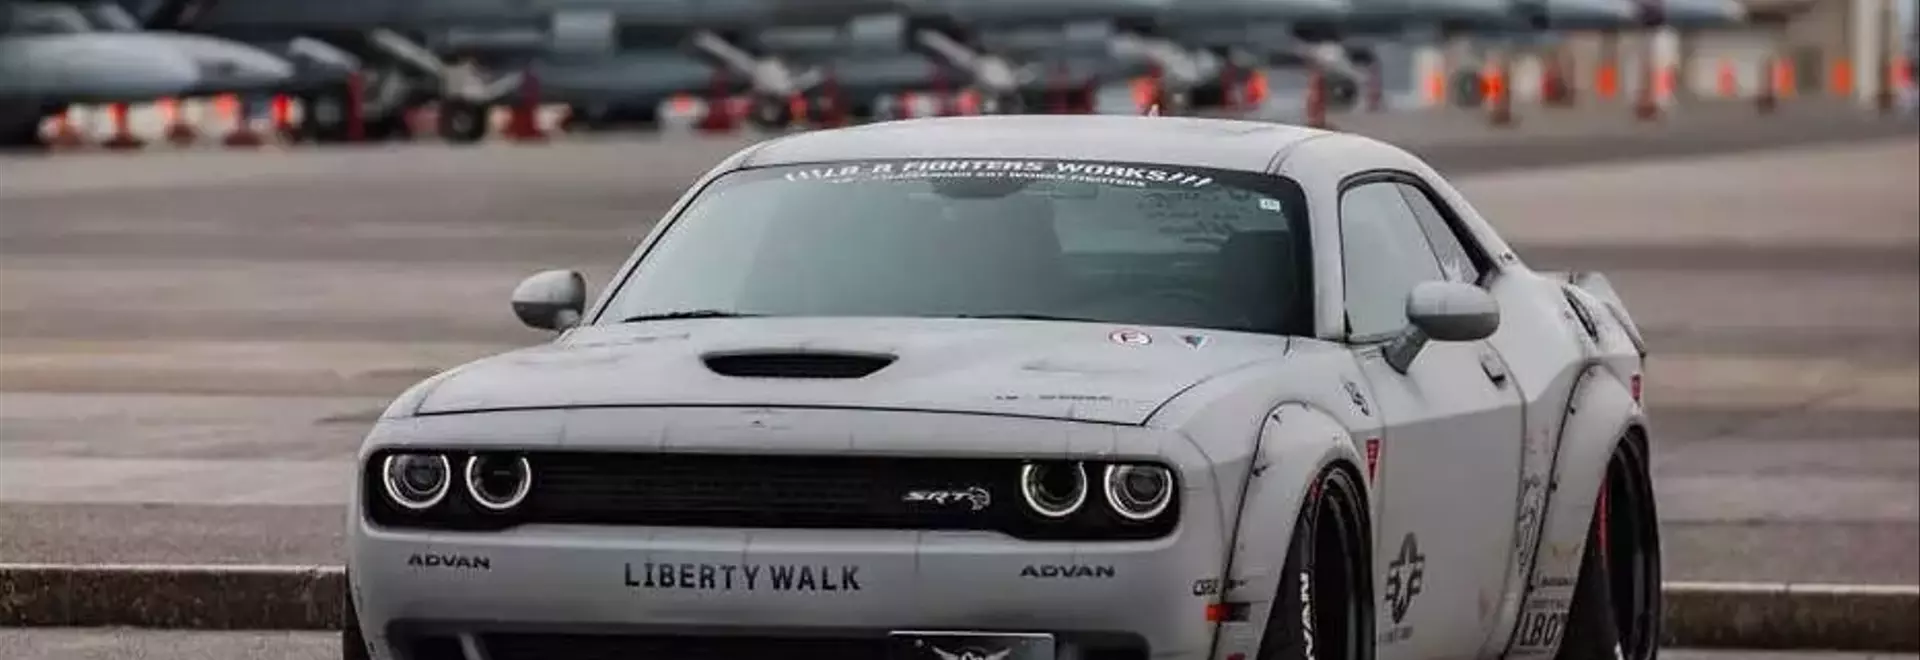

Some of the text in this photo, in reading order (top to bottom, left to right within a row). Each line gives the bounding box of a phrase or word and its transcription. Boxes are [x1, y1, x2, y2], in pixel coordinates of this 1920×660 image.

[902, 159, 1043, 172] FIGHTERS
[902, 489, 968, 505] SRT
[407, 553, 491, 570] ADVAN
[624, 562, 861, 592] LIBERTY WALK
[1019, 564, 1115, 578] ADVAN
[1300, 572, 1315, 660] VAN
